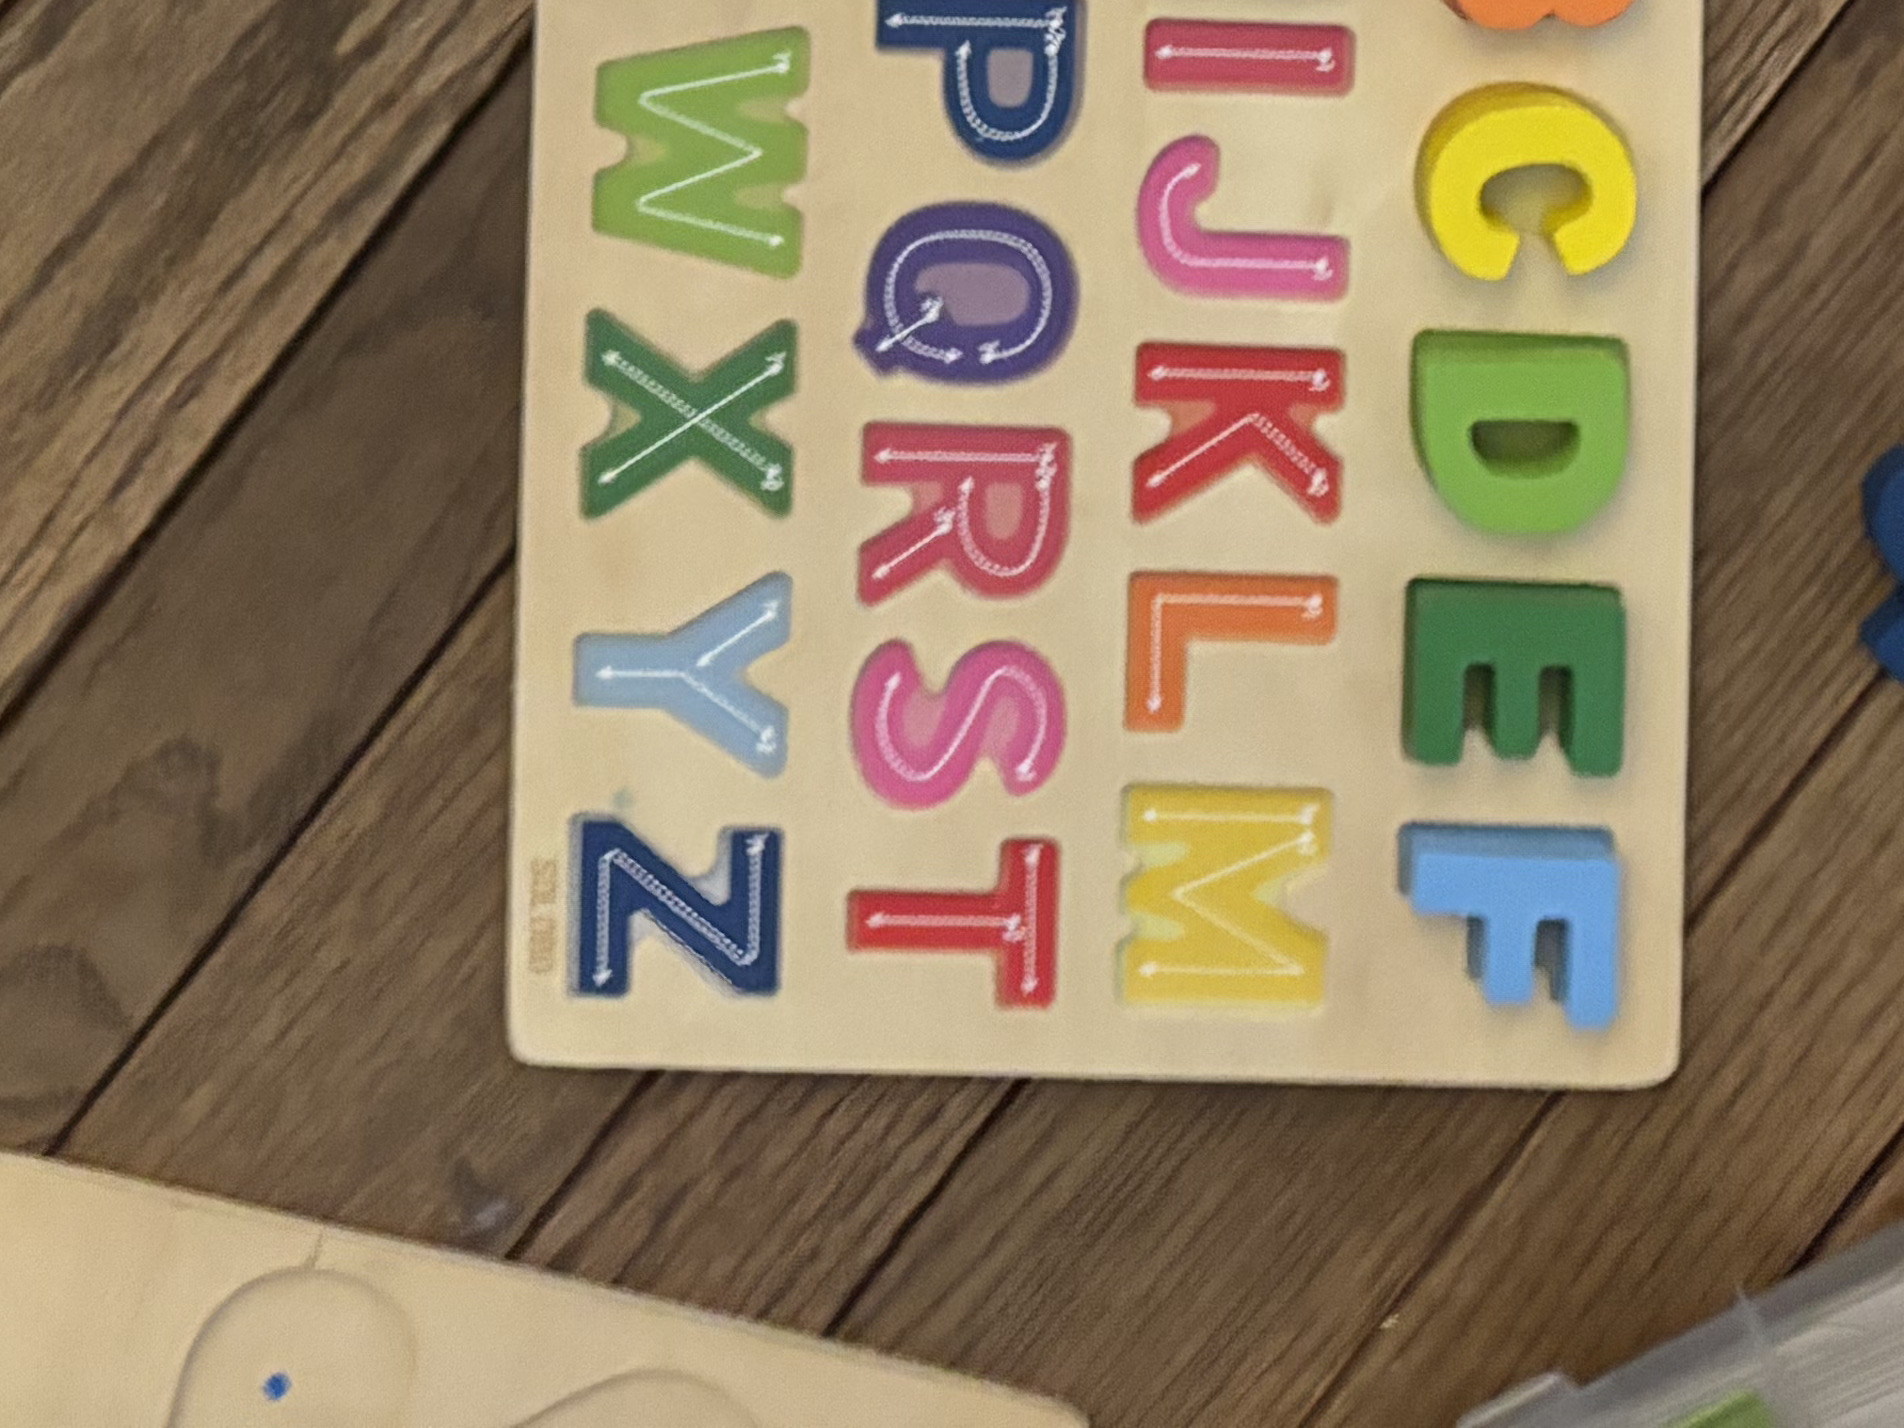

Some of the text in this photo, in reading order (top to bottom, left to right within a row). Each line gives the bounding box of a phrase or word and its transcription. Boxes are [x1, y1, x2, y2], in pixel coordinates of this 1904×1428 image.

[1143, 20, 1357, 93] I
[593, 25, 810, 278] W
[1135, 135, 1349, 301] J
[1414, 82, 1637, 281] C
[851, 202, 1079, 384] Q
[579, 309, 797, 518] X
[1130, 343, 1346, 524] K
[1410, 329, 1630, 537] D
[856, 423, 1072, 606] R
[572, 570, 794, 777] Y
[849, 640, 1066, 809] S
[1125, 570, 1339, 732] L
[1401, 577, 1625, 778] E
[567, 812, 781, 998] Z
[846, 836, 1062, 1010] T
[1117, 784, 1333, 1008] M
[1397, 822, 1620, 1031] F
